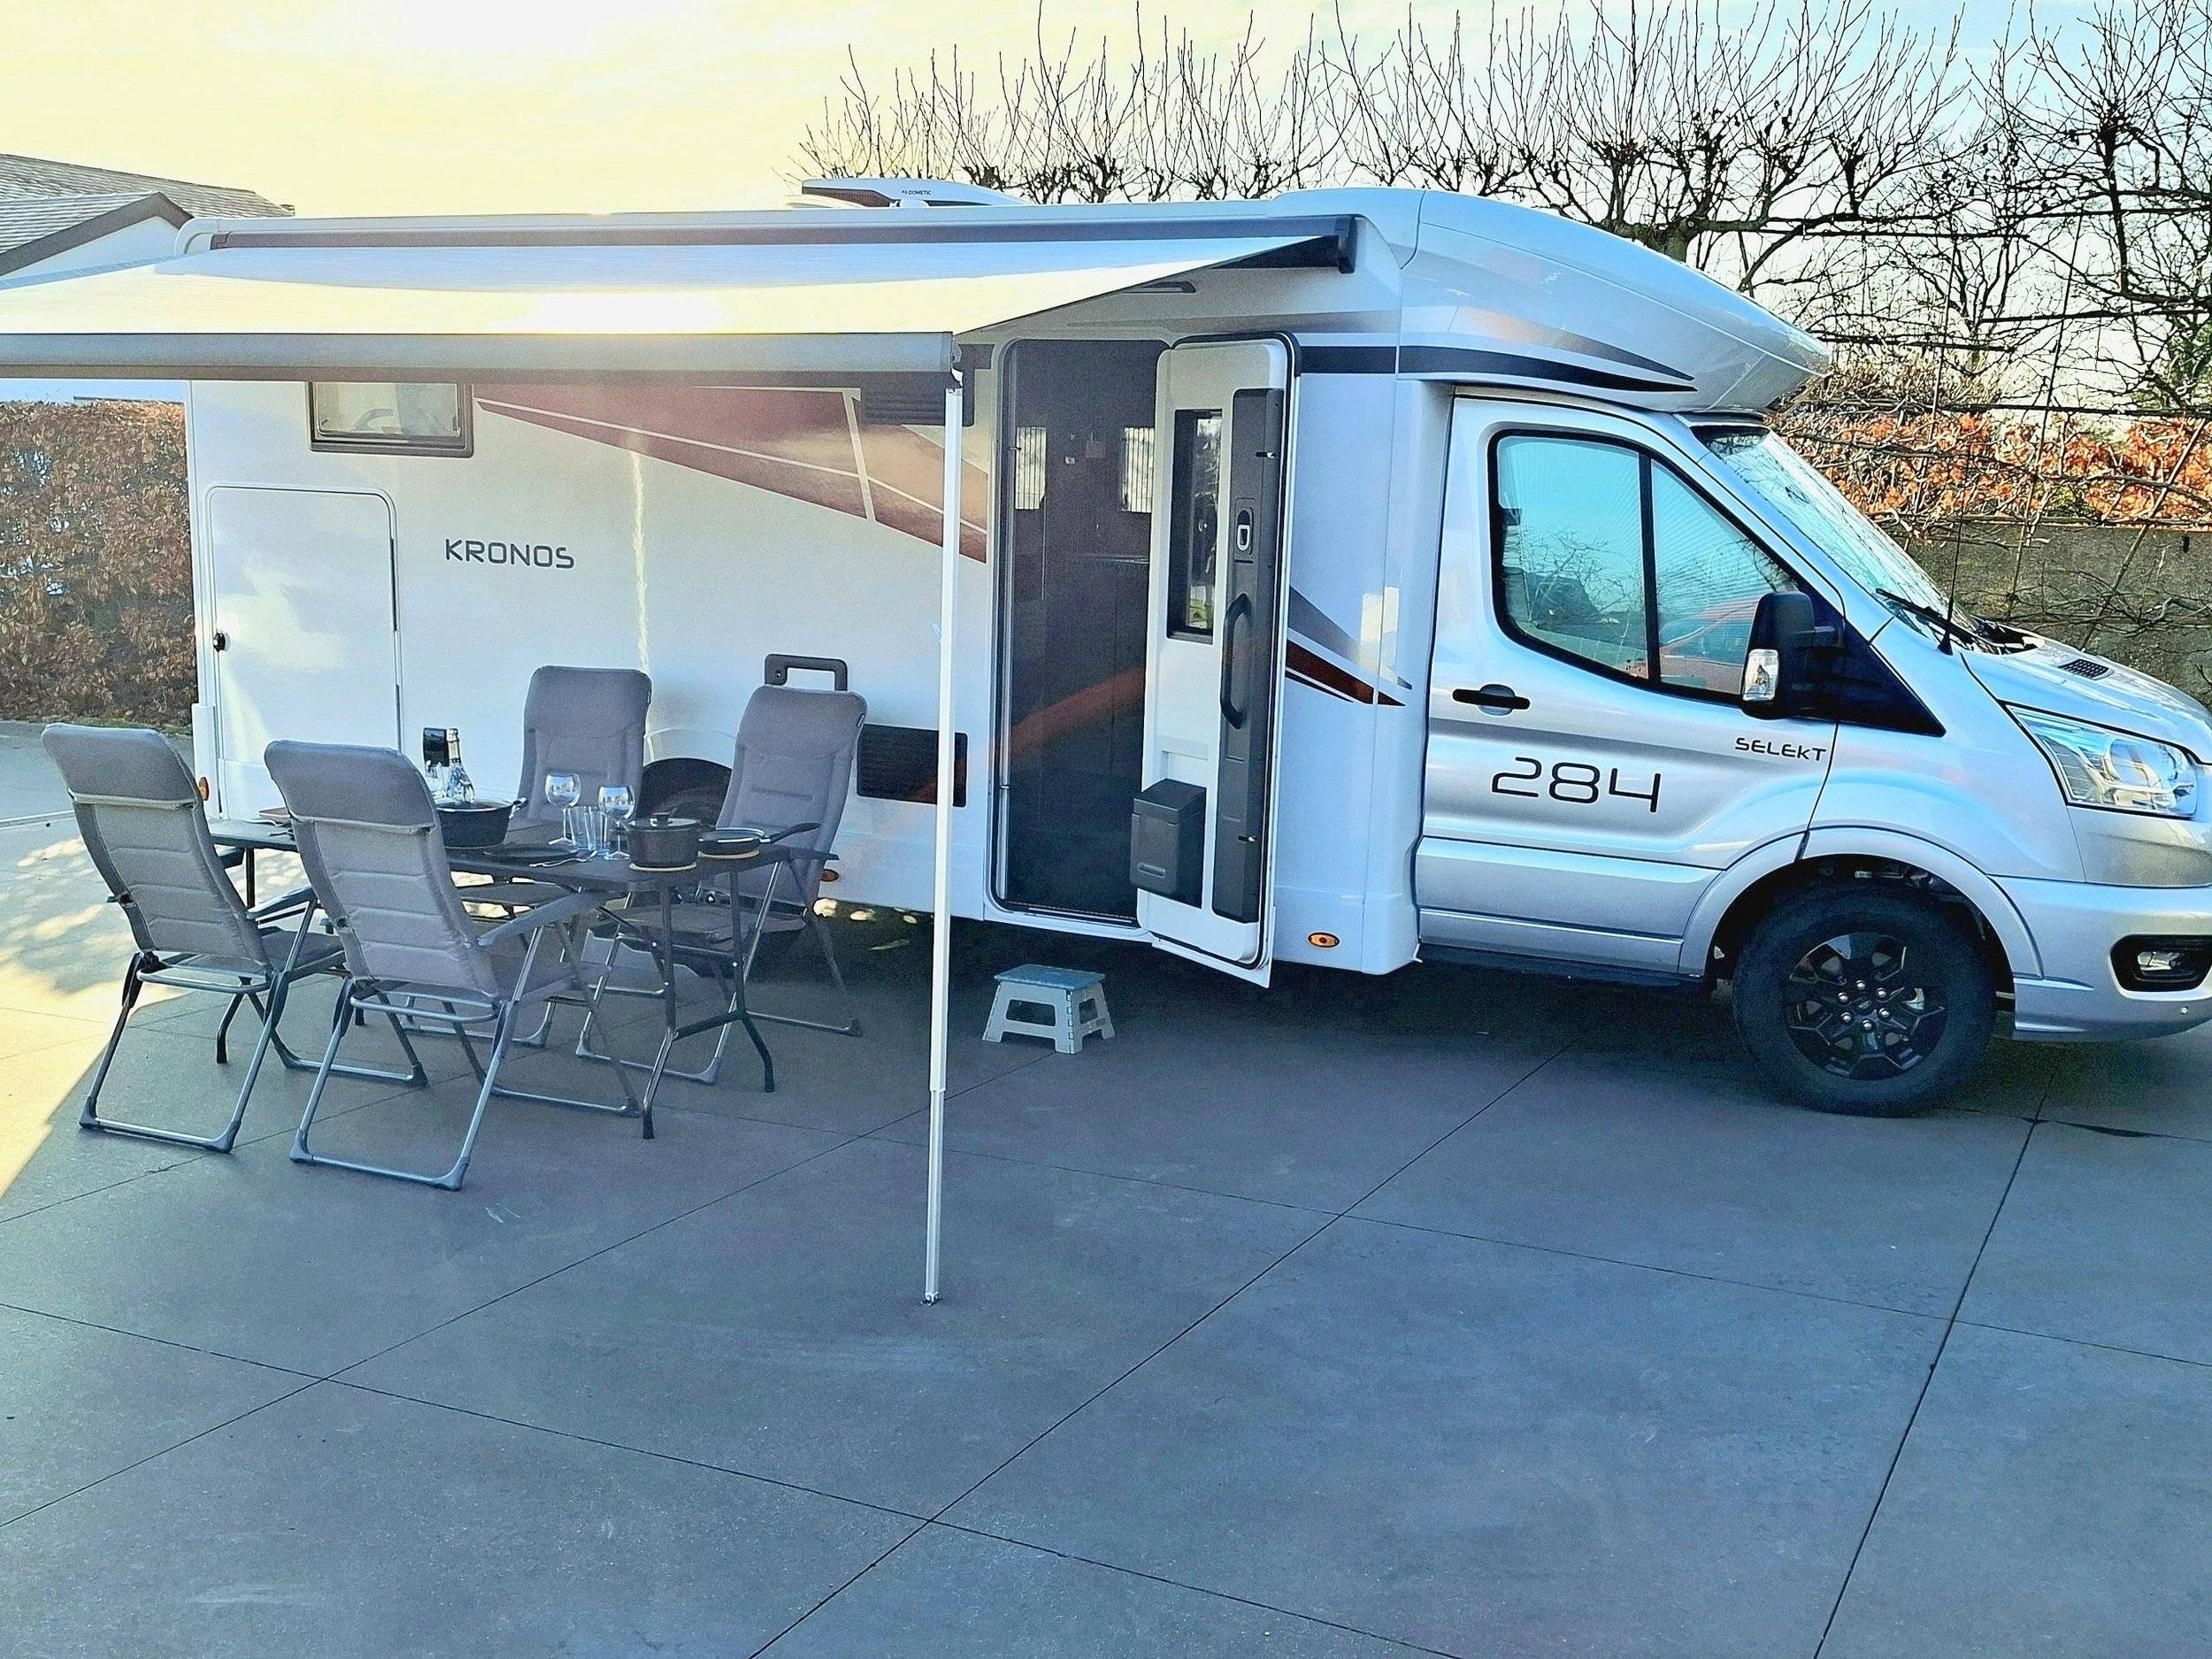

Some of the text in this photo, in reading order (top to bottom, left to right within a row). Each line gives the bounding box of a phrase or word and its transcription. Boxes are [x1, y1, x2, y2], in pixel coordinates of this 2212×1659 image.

[445, 539, 575, 569] KRONOS
[1734, 737, 1827, 762] SELEKT
[1491, 756, 1662, 813] 284
